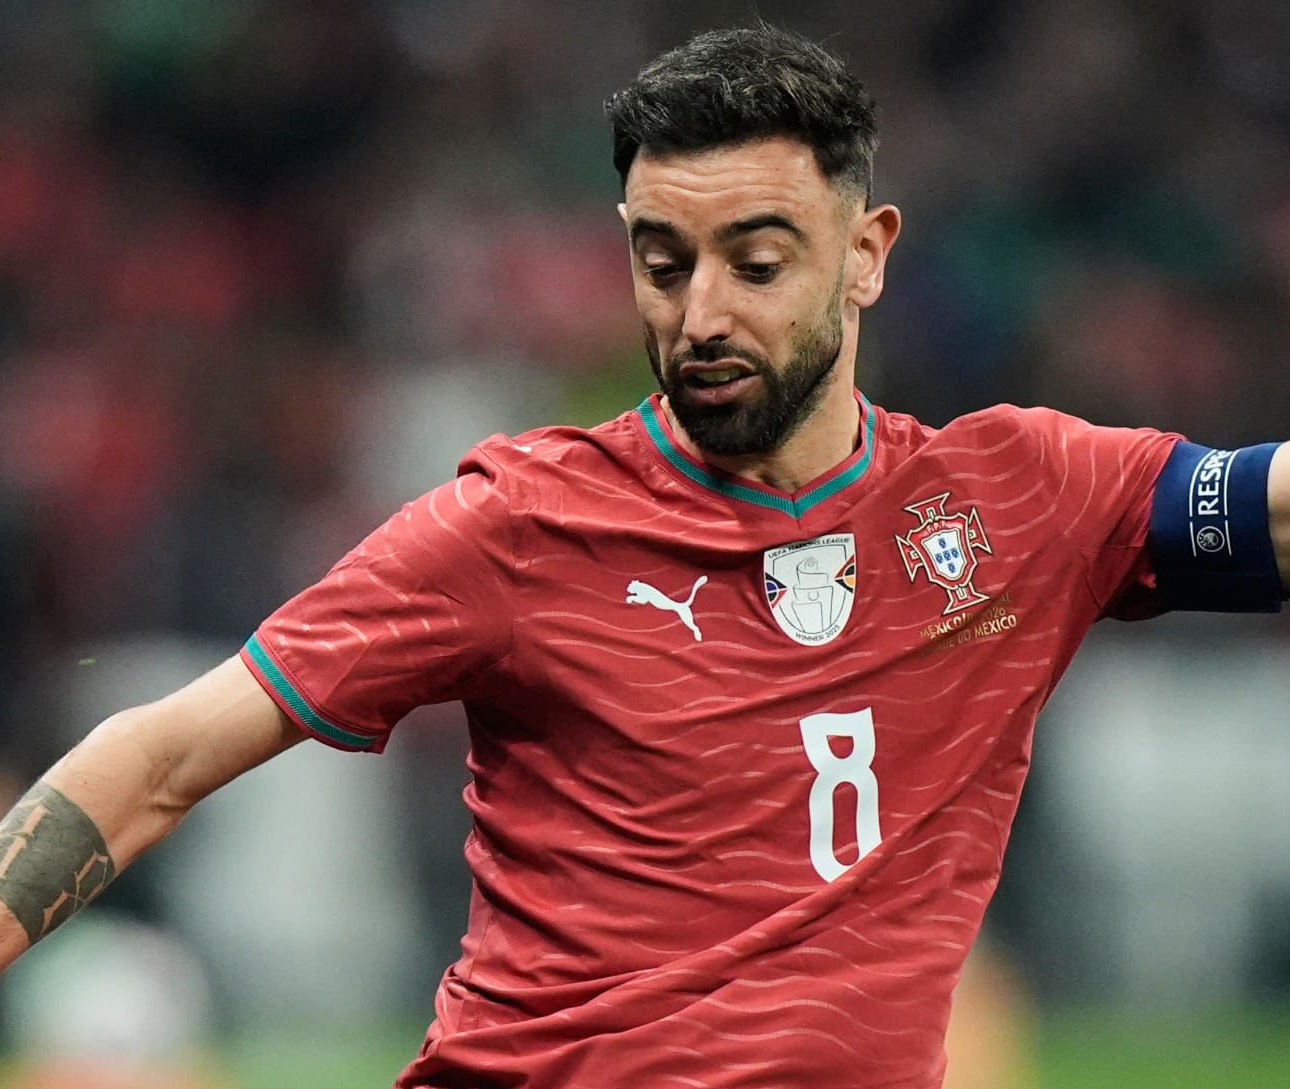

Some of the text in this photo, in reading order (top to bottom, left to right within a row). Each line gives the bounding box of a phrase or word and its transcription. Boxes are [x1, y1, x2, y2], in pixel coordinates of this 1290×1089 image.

[1198, 450, 1233, 515] RESP
[822, 537, 850, 545] LEAGUE
[799, 707, 883, 883] 8
